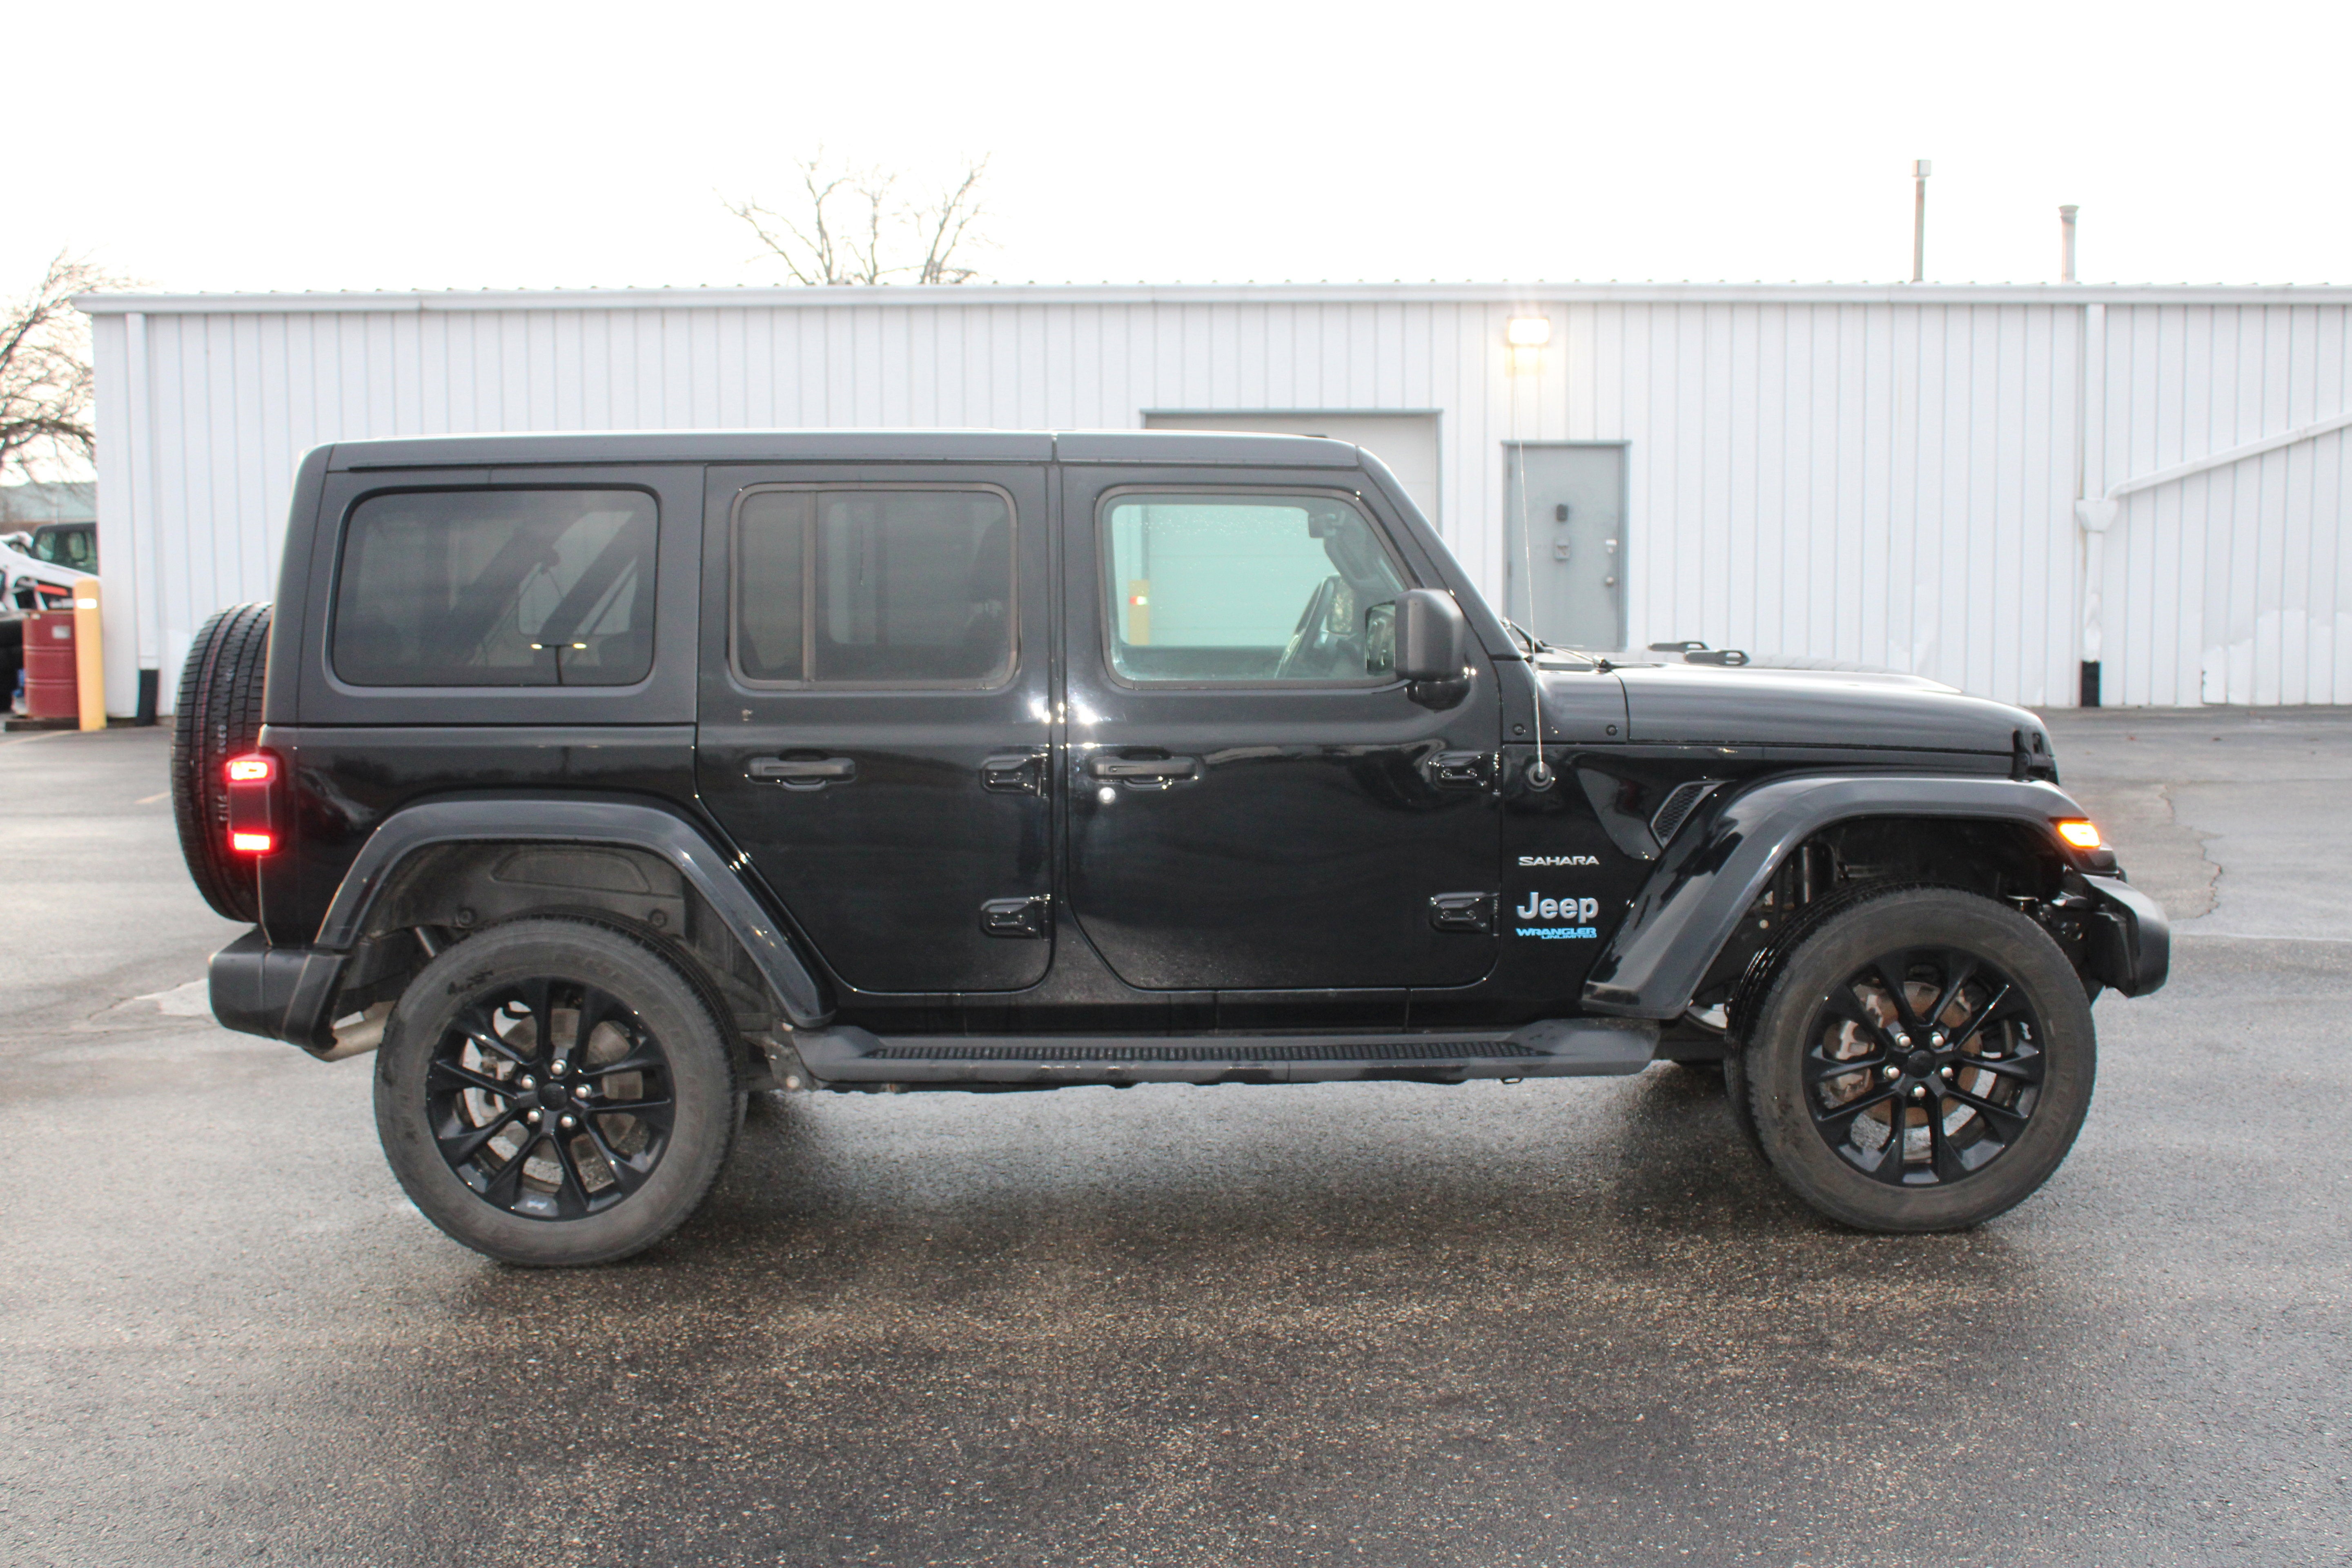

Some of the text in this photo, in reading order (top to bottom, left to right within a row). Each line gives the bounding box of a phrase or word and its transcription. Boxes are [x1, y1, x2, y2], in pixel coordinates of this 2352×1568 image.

[1518, 855, 1599, 866] SAHARA
[1517, 891, 1599, 923] Jeep
[1515, 927, 1597, 936] WRANGLER
